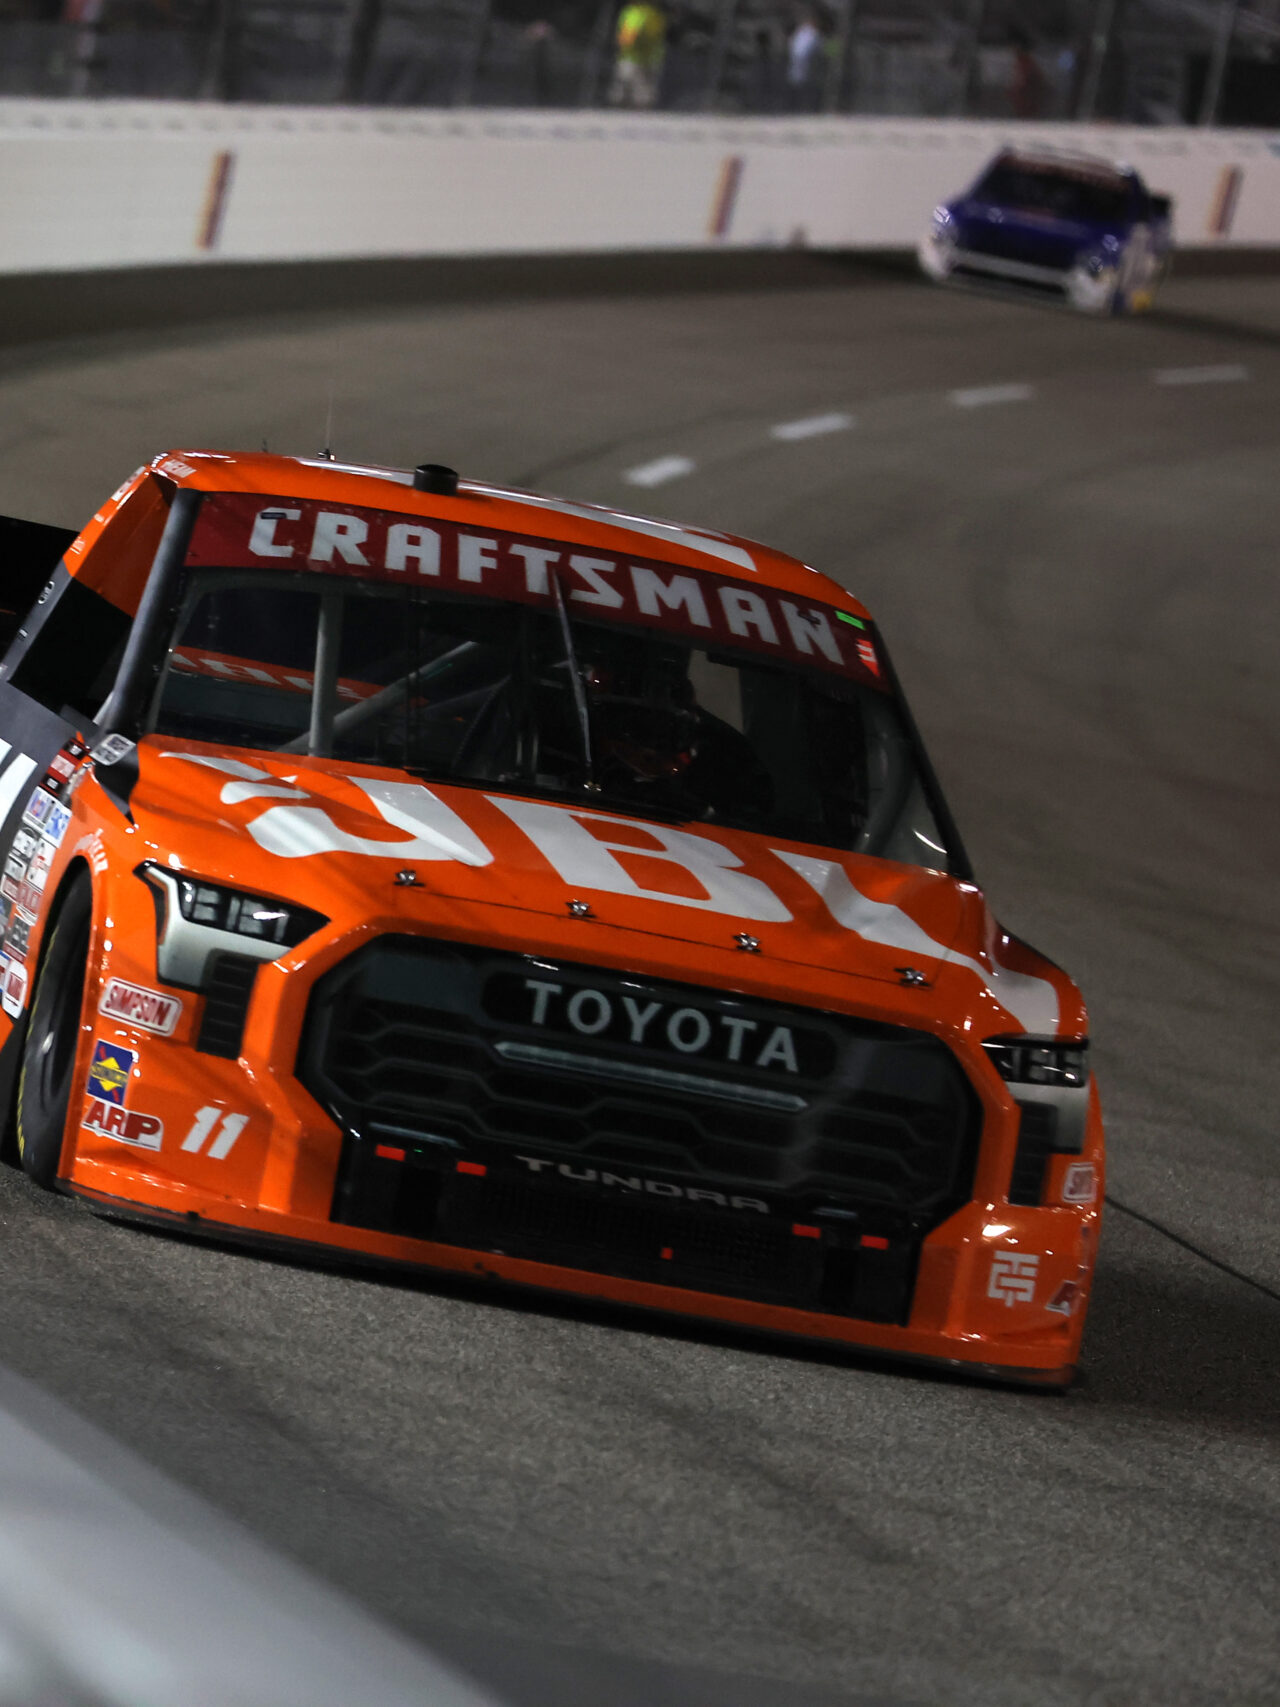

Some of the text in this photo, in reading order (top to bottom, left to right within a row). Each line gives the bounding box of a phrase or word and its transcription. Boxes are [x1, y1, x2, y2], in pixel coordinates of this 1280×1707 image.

[248, 506, 844, 666] CRAFTSMAN
[105, 985, 171, 1027] SIMPSON
[524, 979, 799, 1073] TOYOTA
[85, 1100, 161, 1141] ARP
[180, 1105, 251, 1161] 11
[515, 1155, 771, 1213] TUNDRA
